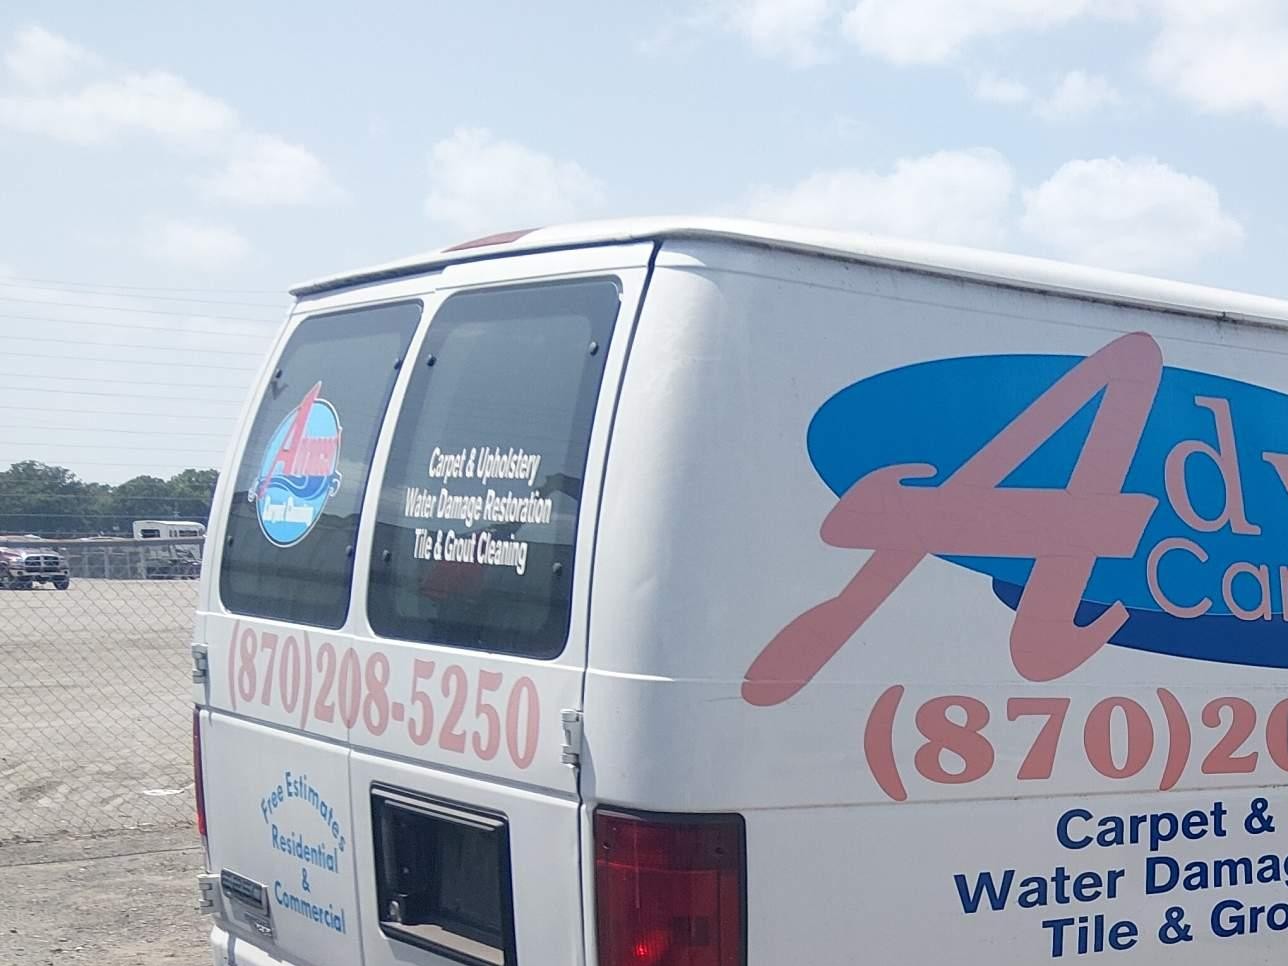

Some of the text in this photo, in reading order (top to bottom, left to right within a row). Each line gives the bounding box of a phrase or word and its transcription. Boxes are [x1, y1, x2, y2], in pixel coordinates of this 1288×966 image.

[429, 446, 541, 486] Carpet & Upholstery
[405, 487, 552, 528] Water Damage Restoration
[414, 528, 528, 575] Tile & Grout Cleaning
[228, 620, 540, 769] (870)208-5250
[260, 771, 346, 852] Free Estimates
[1056, 798, 1227, 853] Carpet
[1243, 797, 1276, 834] &
[272, 824, 339, 873] Residential
[302, 868, 311, 892] &
[953, 864, 1124, 914] Water
[274, 880, 346, 934] Commercial
[1042, 914, 1139, 958] Tile
[1157, 904, 1193, 945] &
